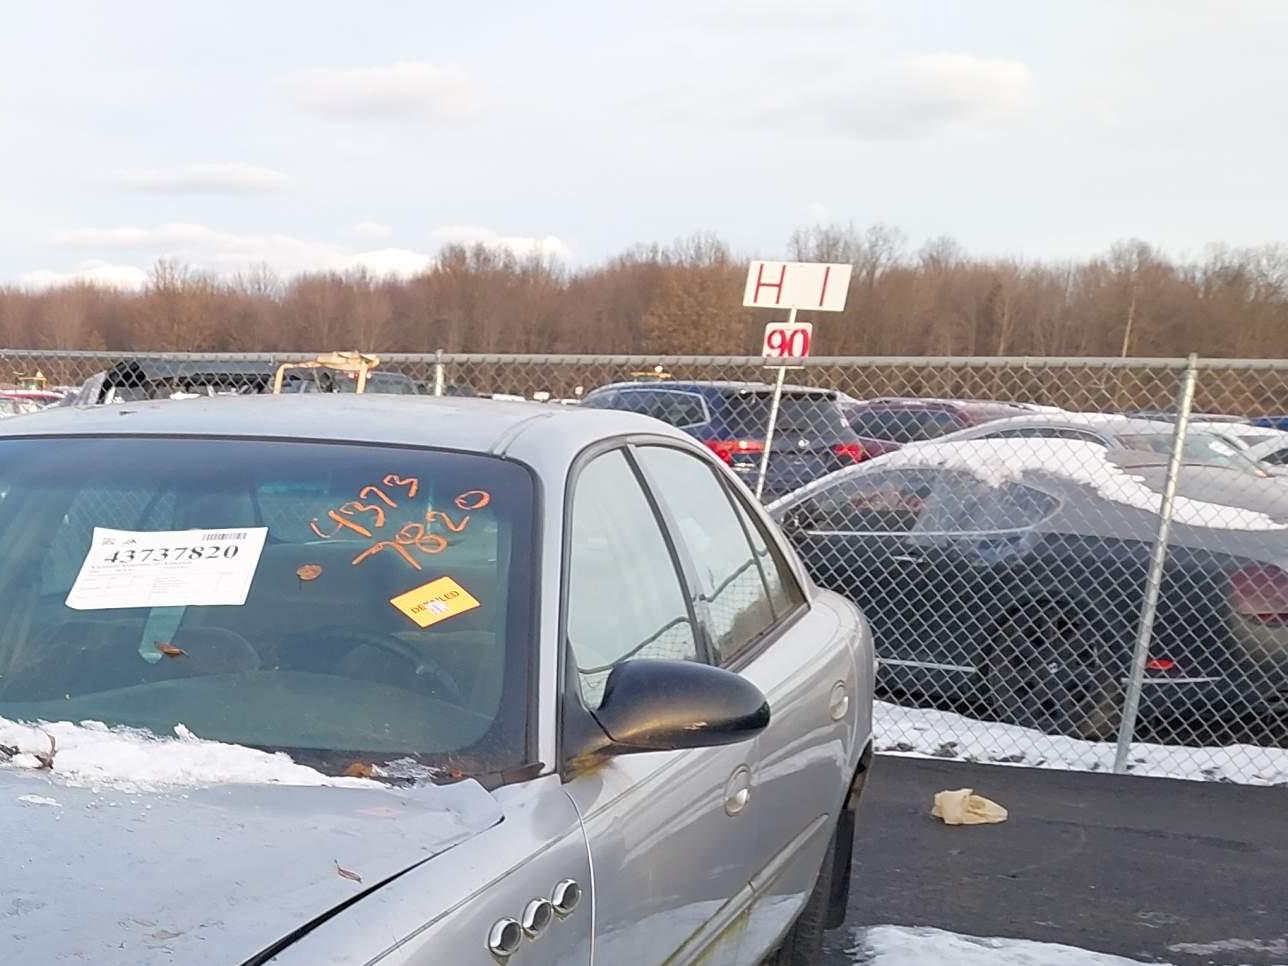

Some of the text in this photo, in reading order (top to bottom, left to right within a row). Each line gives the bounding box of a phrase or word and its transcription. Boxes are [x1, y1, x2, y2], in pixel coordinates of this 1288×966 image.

[753, 263, 787, 305] H
[767, 329, 809, 357] 90
[103, 544, 239, 564] 43737820
